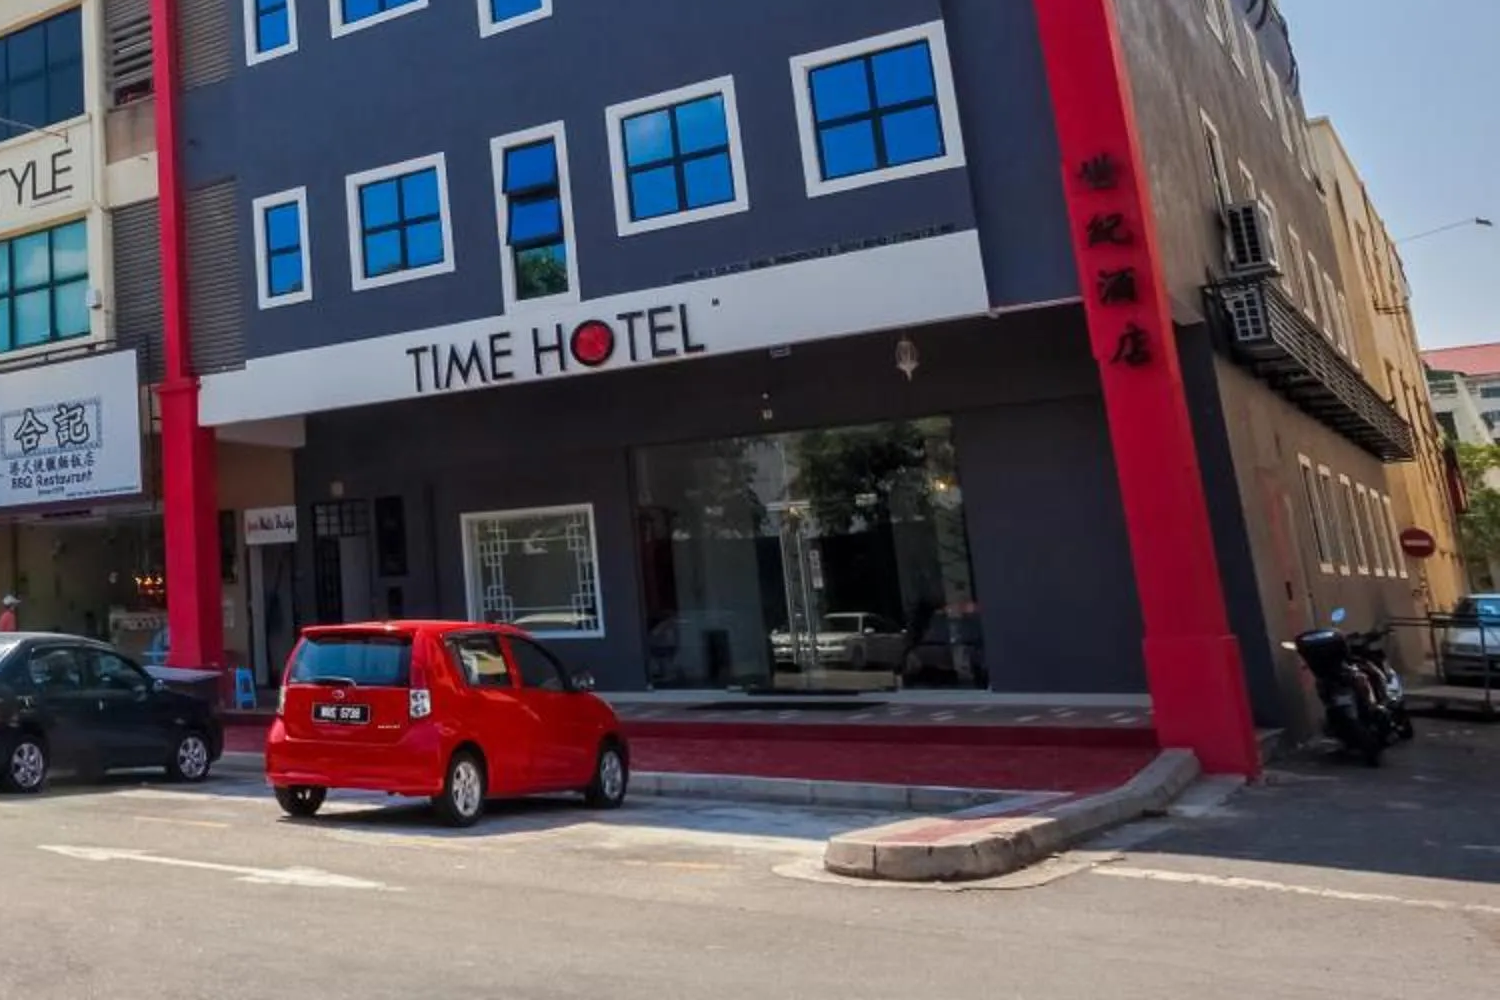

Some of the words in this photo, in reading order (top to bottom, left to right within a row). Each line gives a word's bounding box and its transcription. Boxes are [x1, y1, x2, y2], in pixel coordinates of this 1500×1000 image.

[406, 331, 514, 392] TIME
[531, 303, 705, 374] HOTEL
[13, 402, 91, 454] 合記
[11, 475, 33, 489] BBQ
[35, 468, 93, 487] Restaurant
